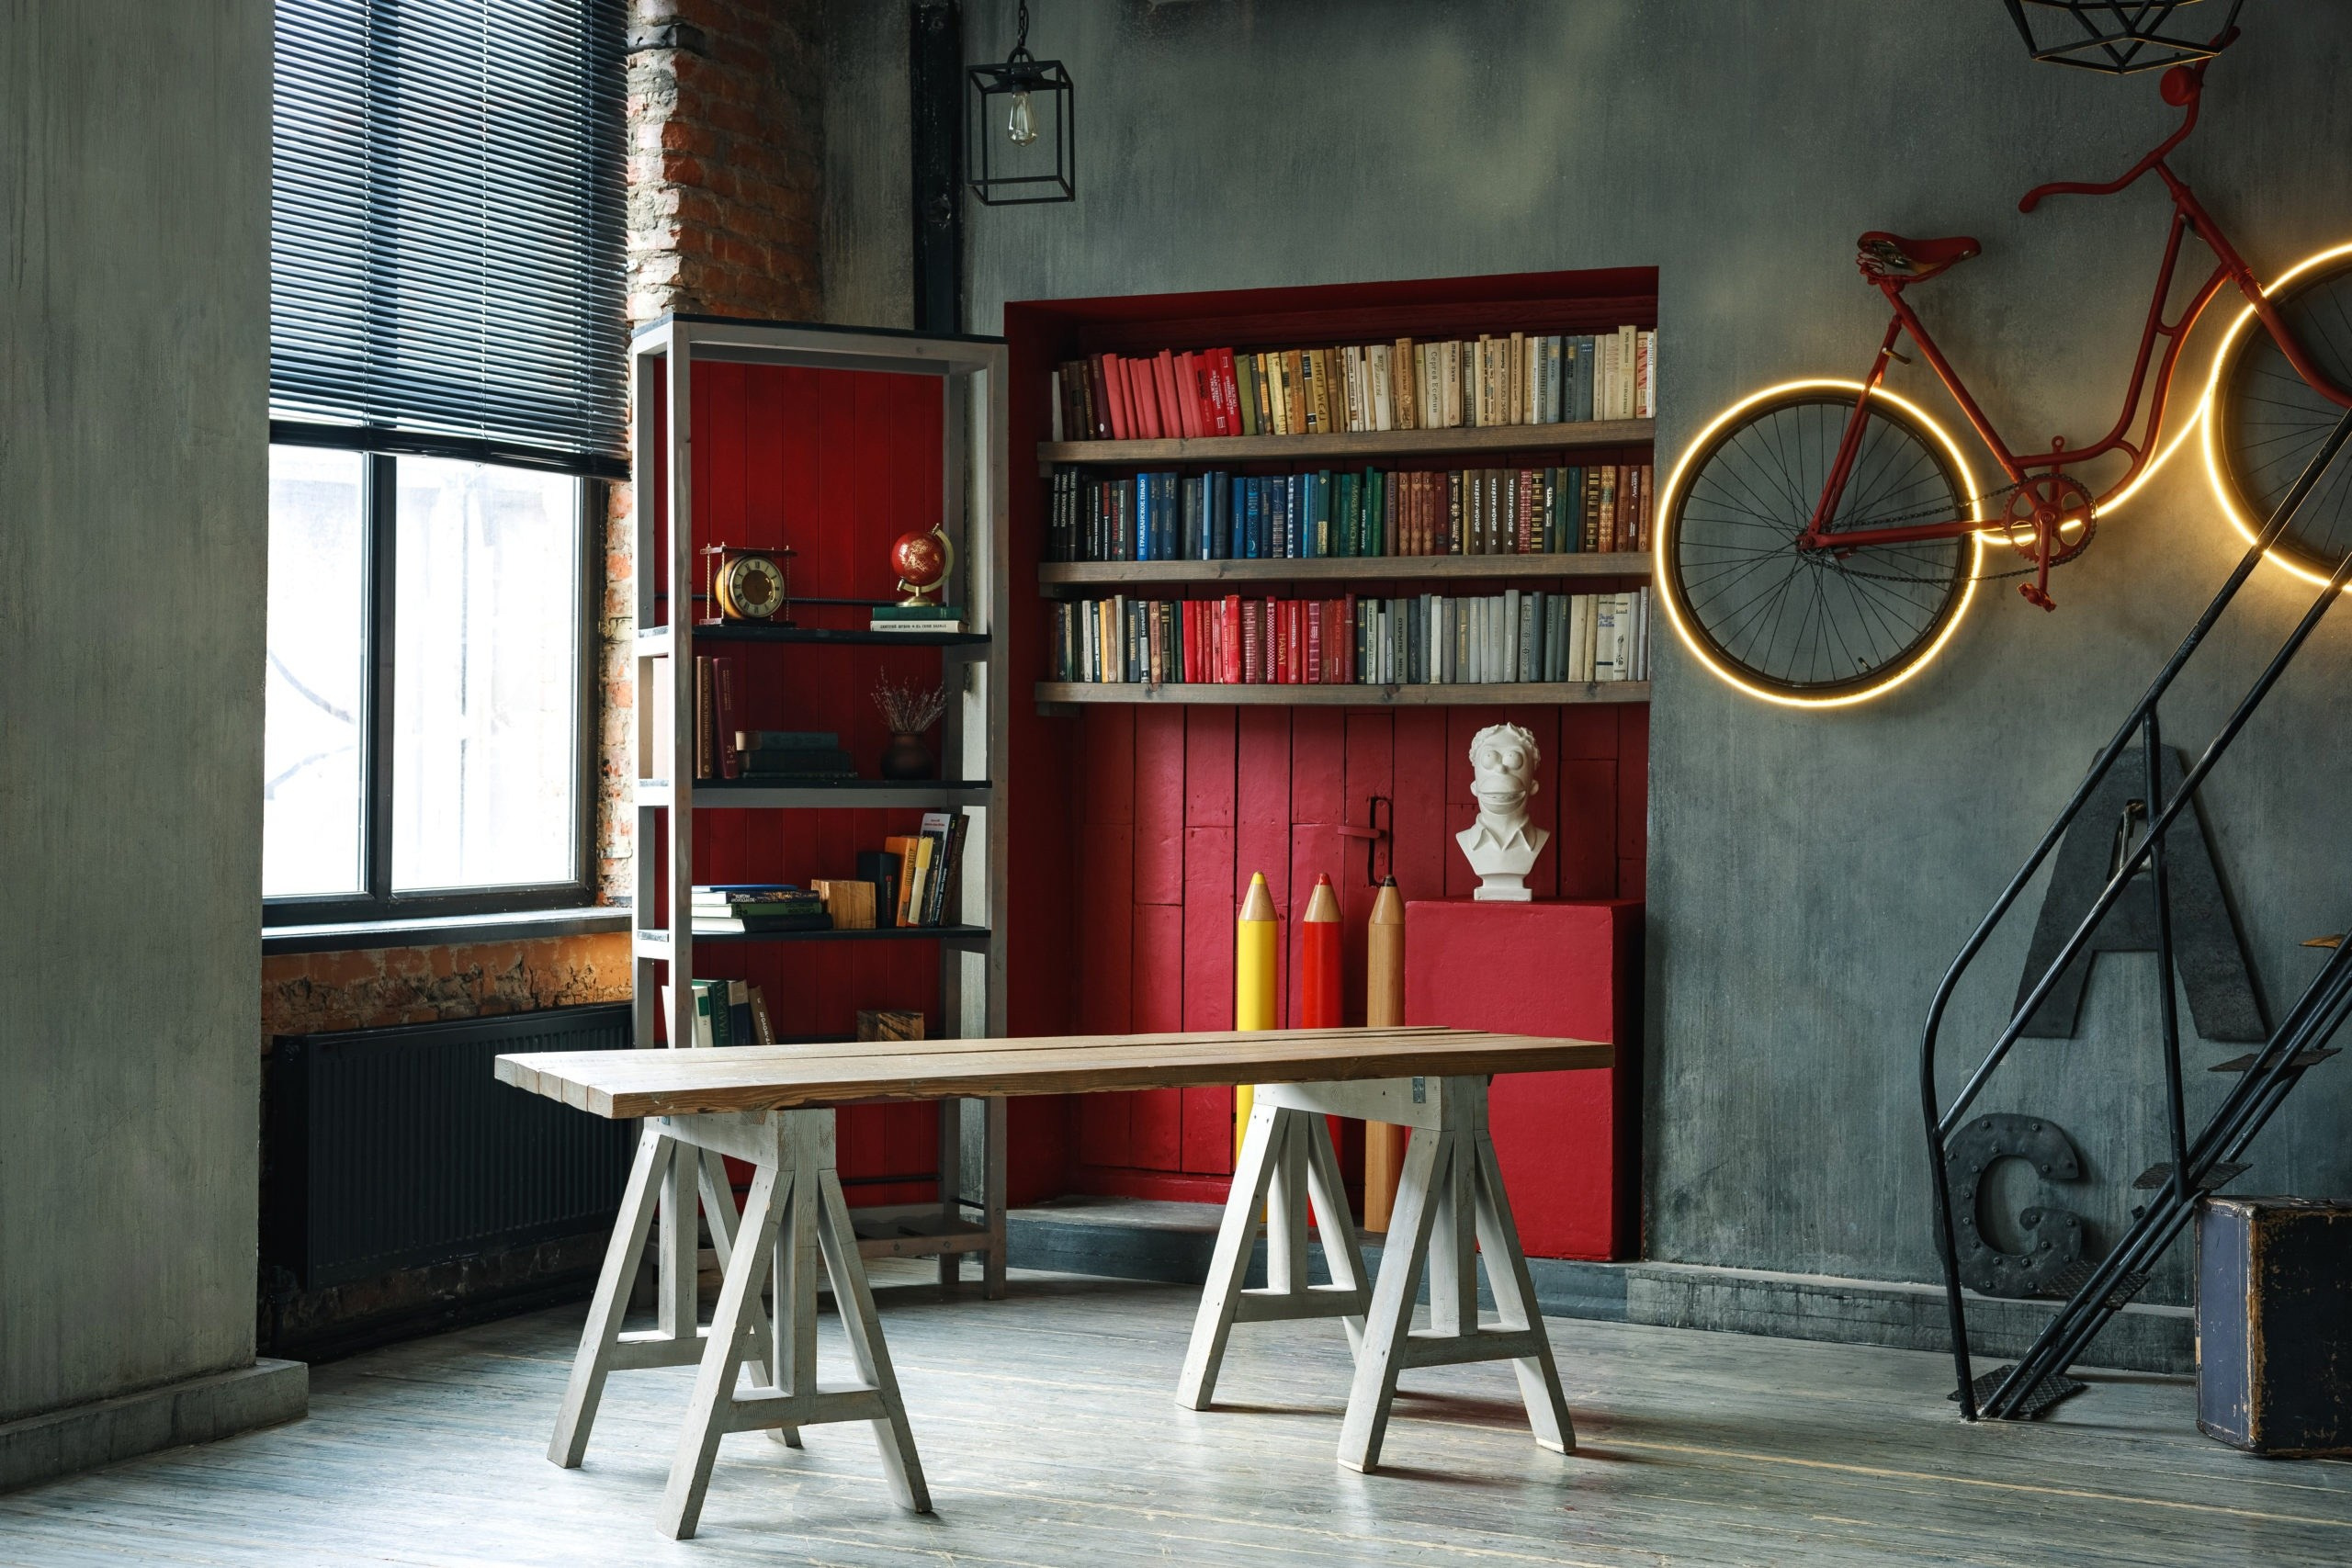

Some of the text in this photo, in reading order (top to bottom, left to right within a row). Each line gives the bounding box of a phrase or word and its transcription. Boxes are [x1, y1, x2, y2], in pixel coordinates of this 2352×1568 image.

[1430, 352, 1438, 380] Сергей
[1315, 362, 1327, 420] ГРЭМ ГРИН
[727, 745, 735, 753] 24
[2008, 746, 2267, 1039] A
